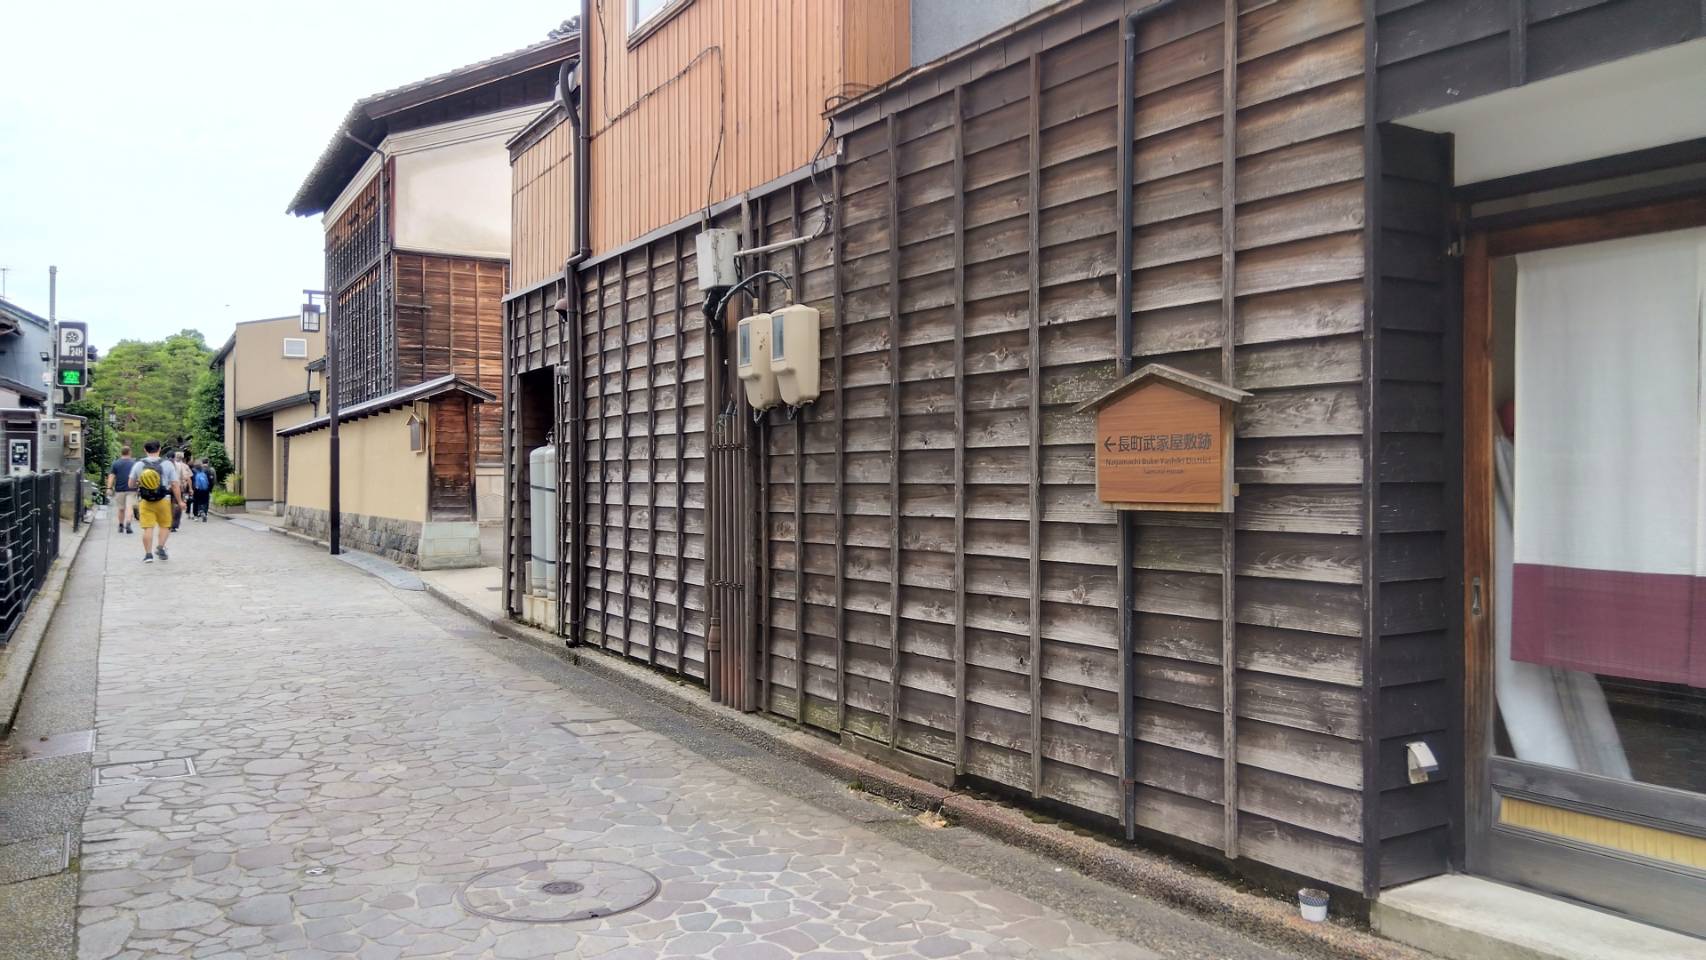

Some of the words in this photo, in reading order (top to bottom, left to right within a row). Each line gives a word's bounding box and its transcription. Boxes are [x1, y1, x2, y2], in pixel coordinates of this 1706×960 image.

[61, 328, 84, 356] P
[71, 347, 83, 356] 24H
[1118, 432, 1212, 452] 長町武家屋敷跡
[1105, 458, 1140, 467] Nagamachi
